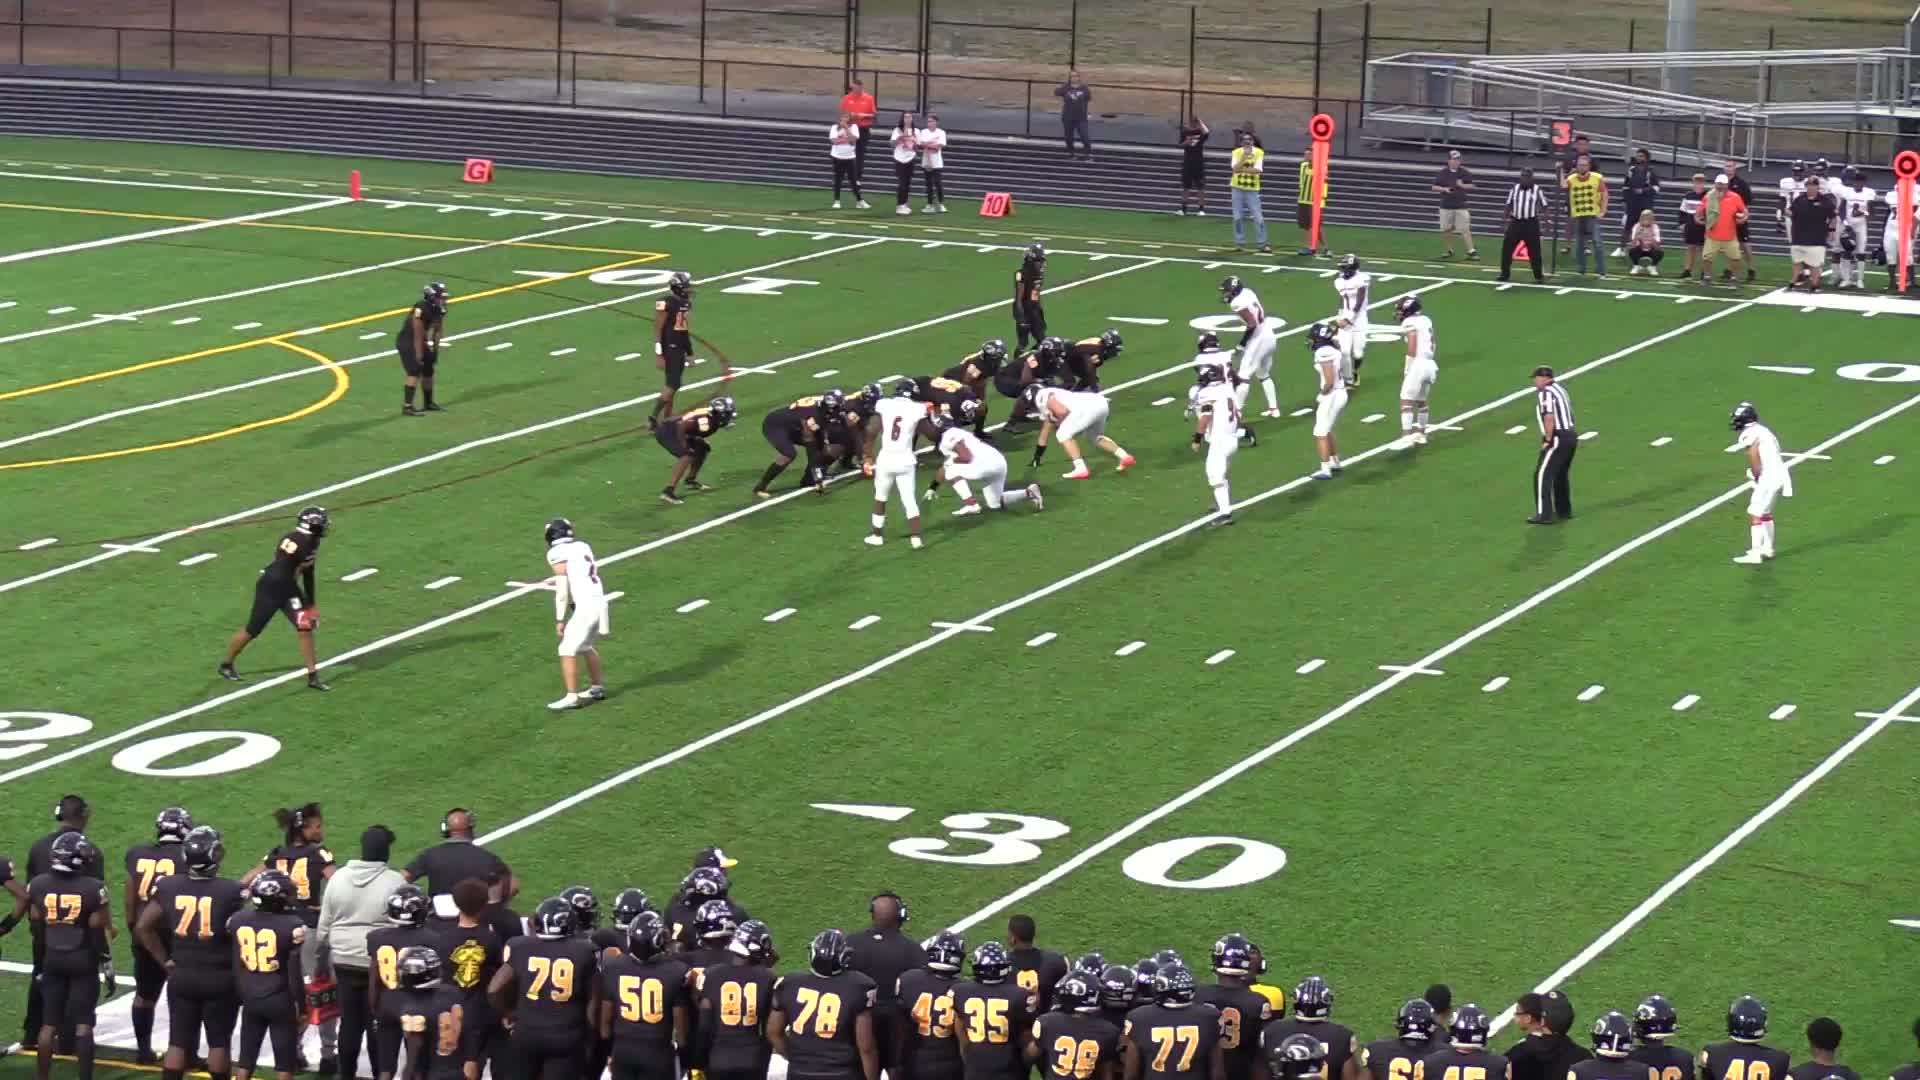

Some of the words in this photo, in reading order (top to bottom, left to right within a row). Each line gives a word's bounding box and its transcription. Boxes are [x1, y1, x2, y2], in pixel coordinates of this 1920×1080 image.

[467, 161, 487, 180] G
[986, 195, 1004, 214] 10
[891, 416, 903, 441] 6
[44, 893, 82, 925] 17
[174, 895, 214, 937] 71
[236, 926, 280, 972] 82
[526, 956, 574, 1002] 79
[619, 975, 664, 1024] 50
[720, 981, 758, 1026] 81
[793, 987, 841, 1039] 78
[911, 992, 954, 1037] 43
[964, 997, 1009, 1042] 35
[1151, 1025, 1198, 1072] 77
